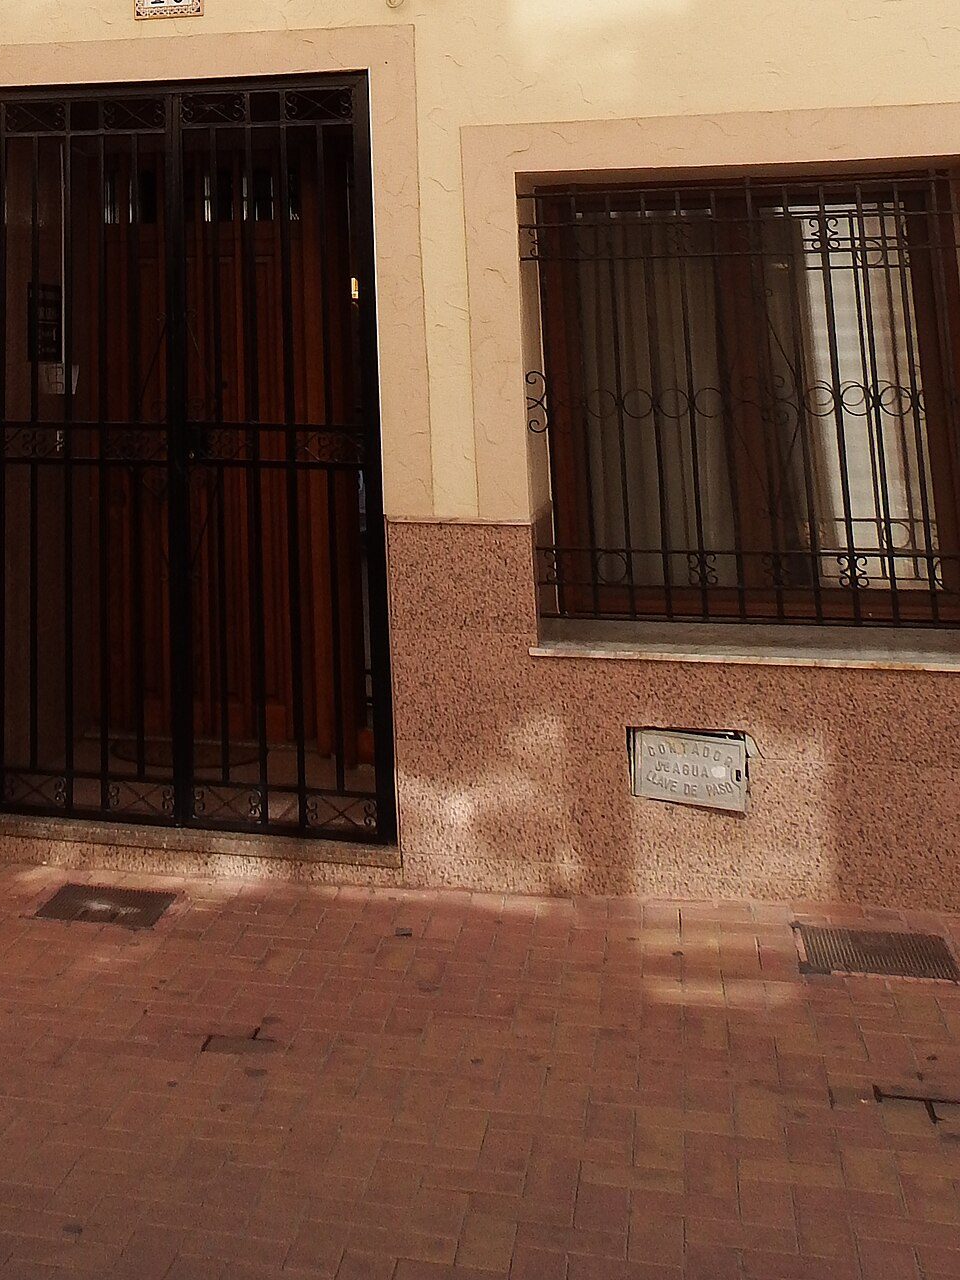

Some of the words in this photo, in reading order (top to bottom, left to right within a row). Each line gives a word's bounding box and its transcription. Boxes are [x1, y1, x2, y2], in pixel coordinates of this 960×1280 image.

[647, 742, 733, 768] CONTADOR
[673, 762, 709, 778] AGUA
[647, 770, 677, 793] LLAVE
[684, 783, 698, 796] DE
[706, 782, 733, 797] PASO
